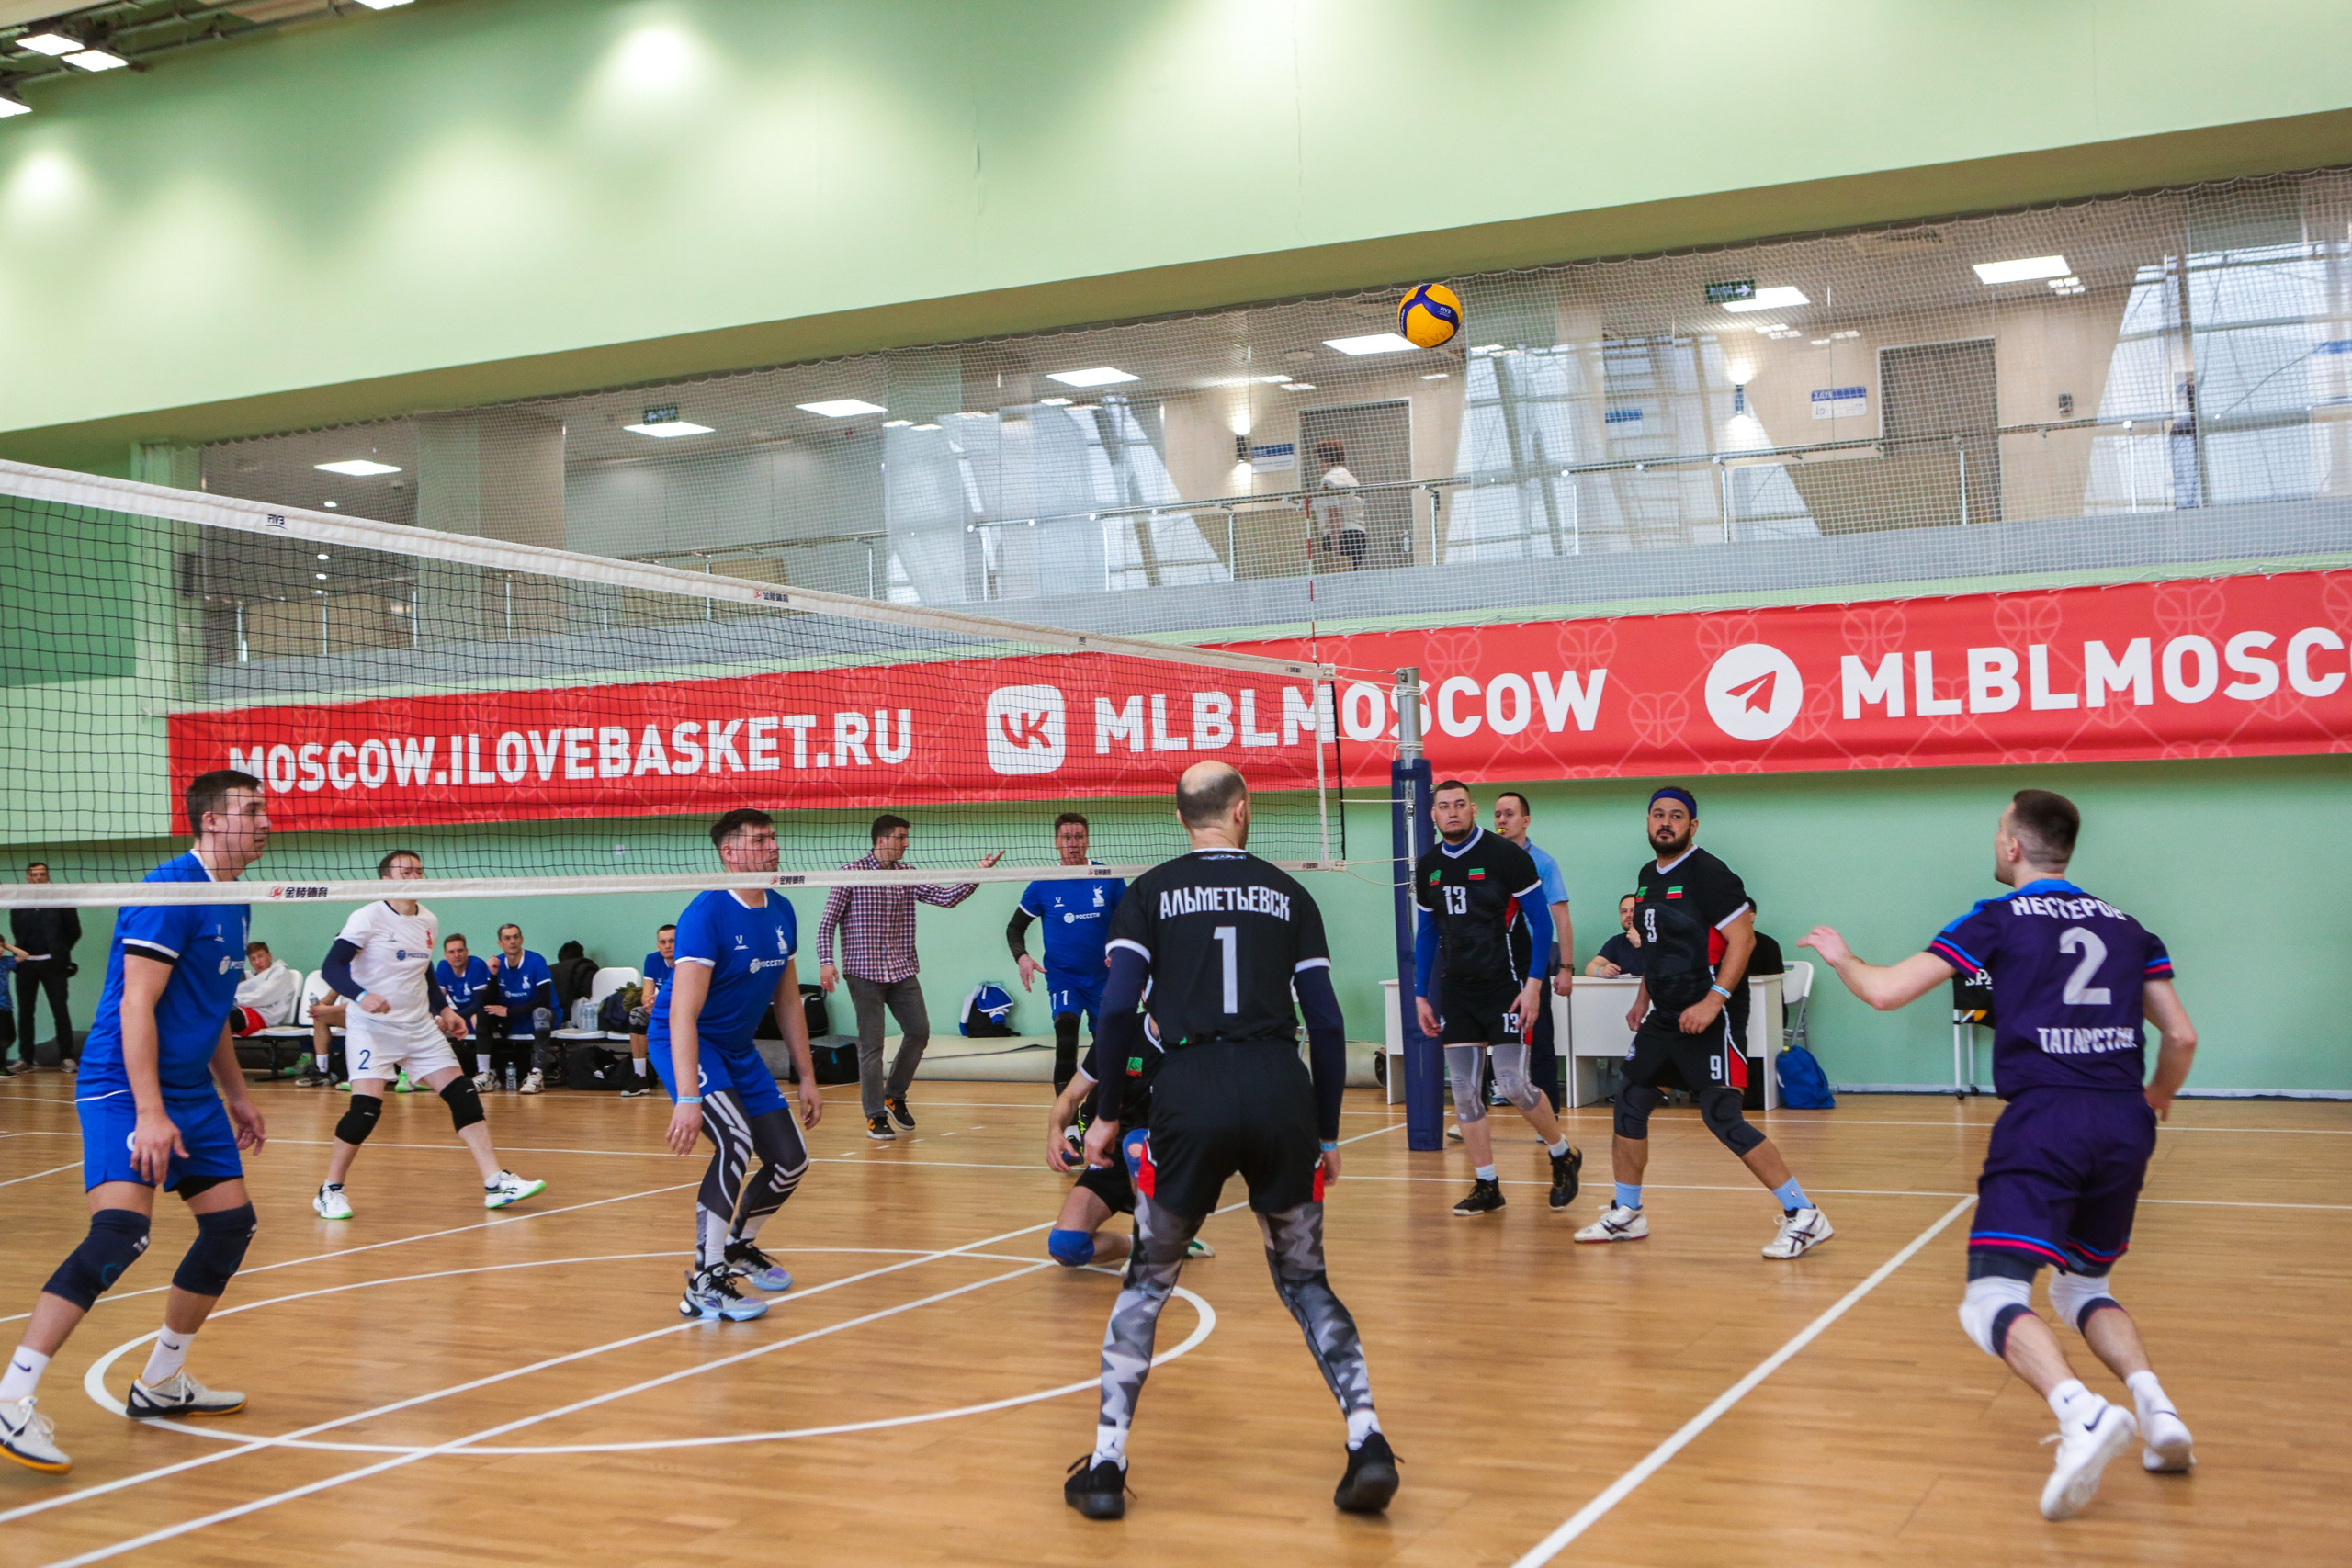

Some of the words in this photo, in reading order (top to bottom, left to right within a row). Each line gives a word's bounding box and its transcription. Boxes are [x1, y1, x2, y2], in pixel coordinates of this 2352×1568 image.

[267, 513, 285, 525] FIVB
[1840, 626, 2352, 720] MLBLMOSC
[1094, 668, 1608, 754] MLBLMOSCOW
[230, 708, 912, 794] MOSCOW.ILOVEBASKET.RU
[1075, 912, 1101, 920] РОССЕТИ
[1160, 886, 1291, 922] АЛЬМЕТЬЕВСК
[1442, 886, 1468, 915] 13
[1644, 908, 1657, 942] 9
[1213, 926, 1238, 1014] 1
[2059, 926, 2111, 1005] 2
[1052, 989, 1069, 1010] 11
[1502, 1012, 1521, 1034] 13
[358, 1049, 371, 1070] 2
[1710, 1055, 1723, 1080] 9
